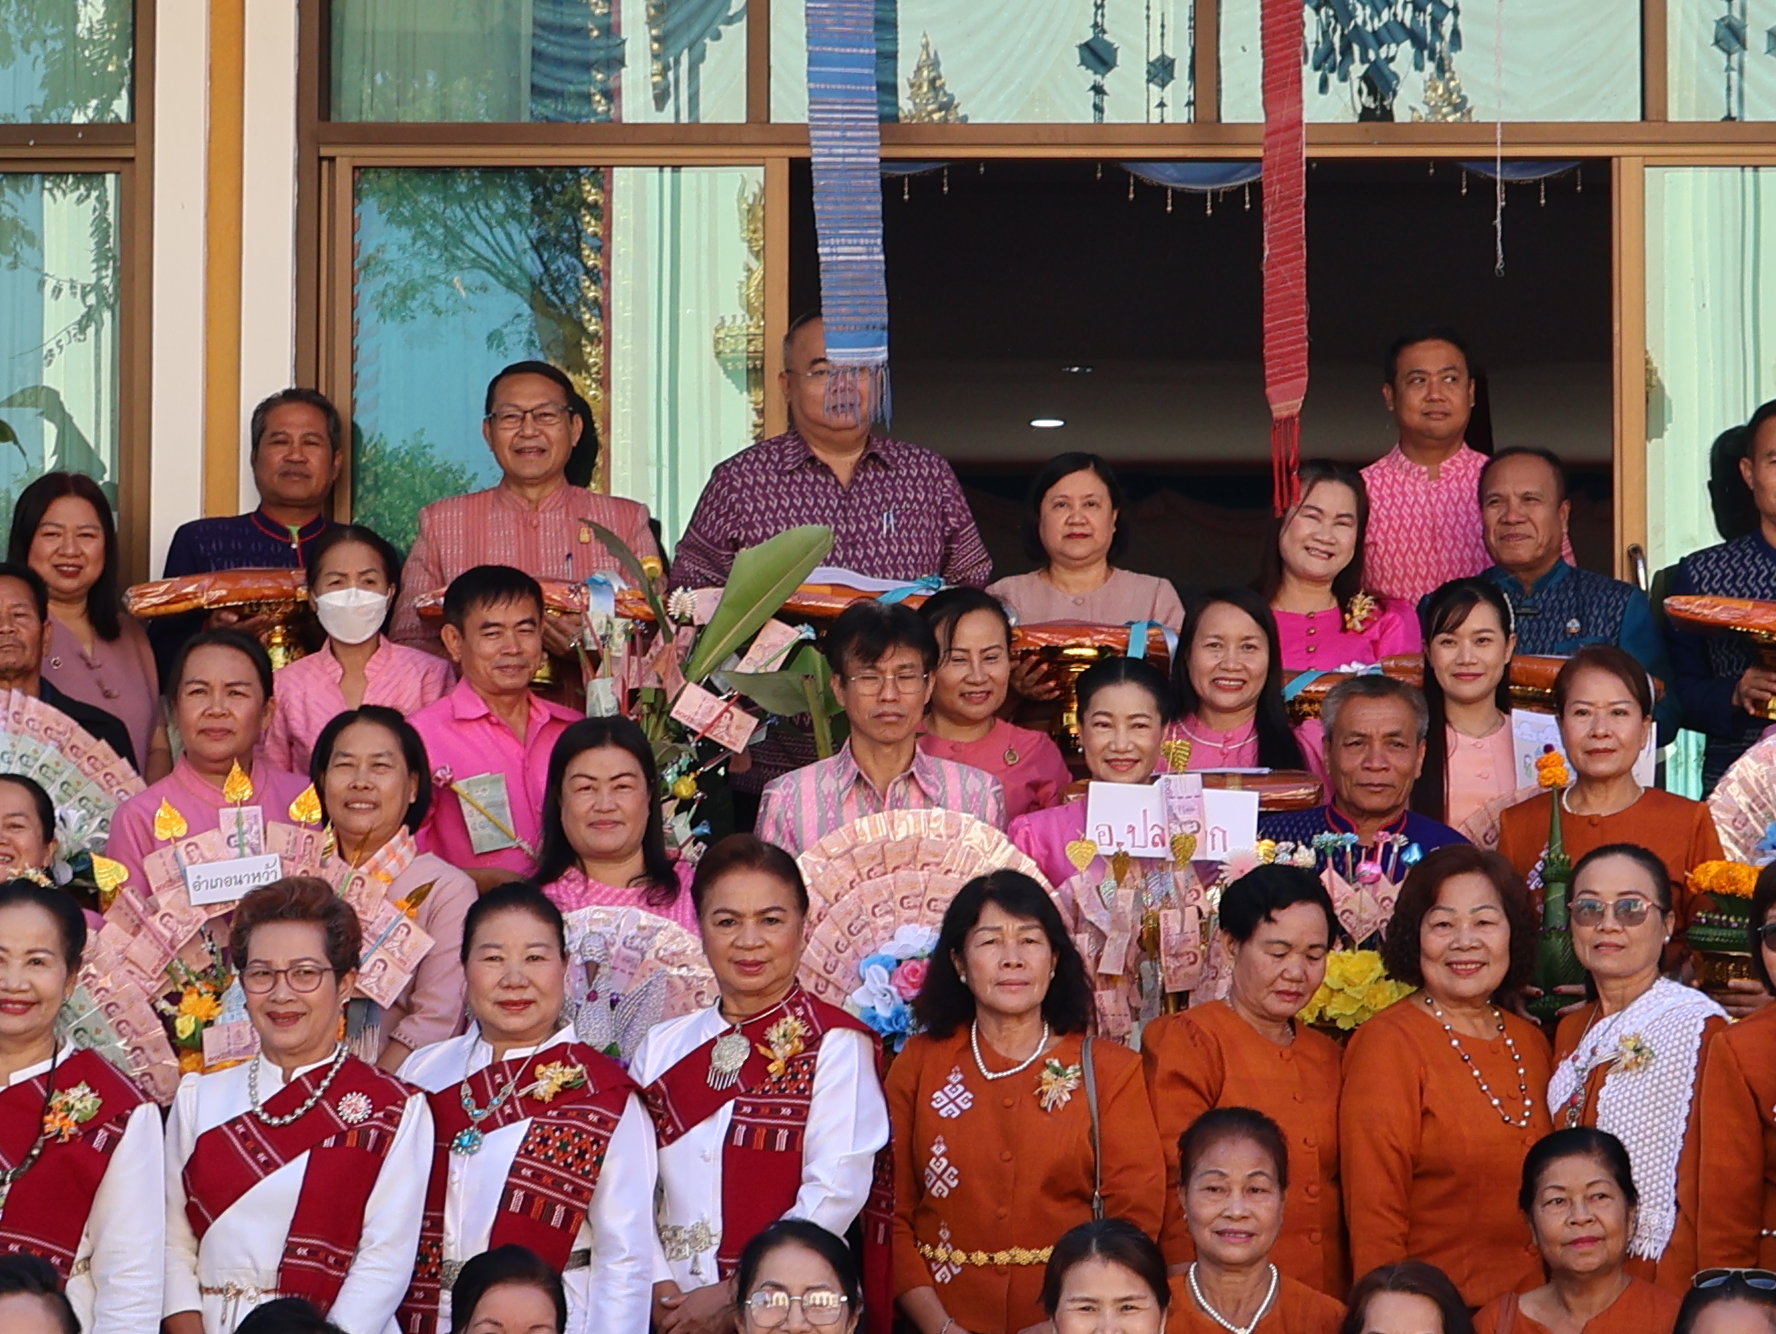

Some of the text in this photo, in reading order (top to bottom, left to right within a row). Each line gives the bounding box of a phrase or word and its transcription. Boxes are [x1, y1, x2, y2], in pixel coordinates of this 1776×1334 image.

[1095, 808, 1228, 853] อ.ปลก
[191, 857, 278, 892] อำเภอนาหว้า
